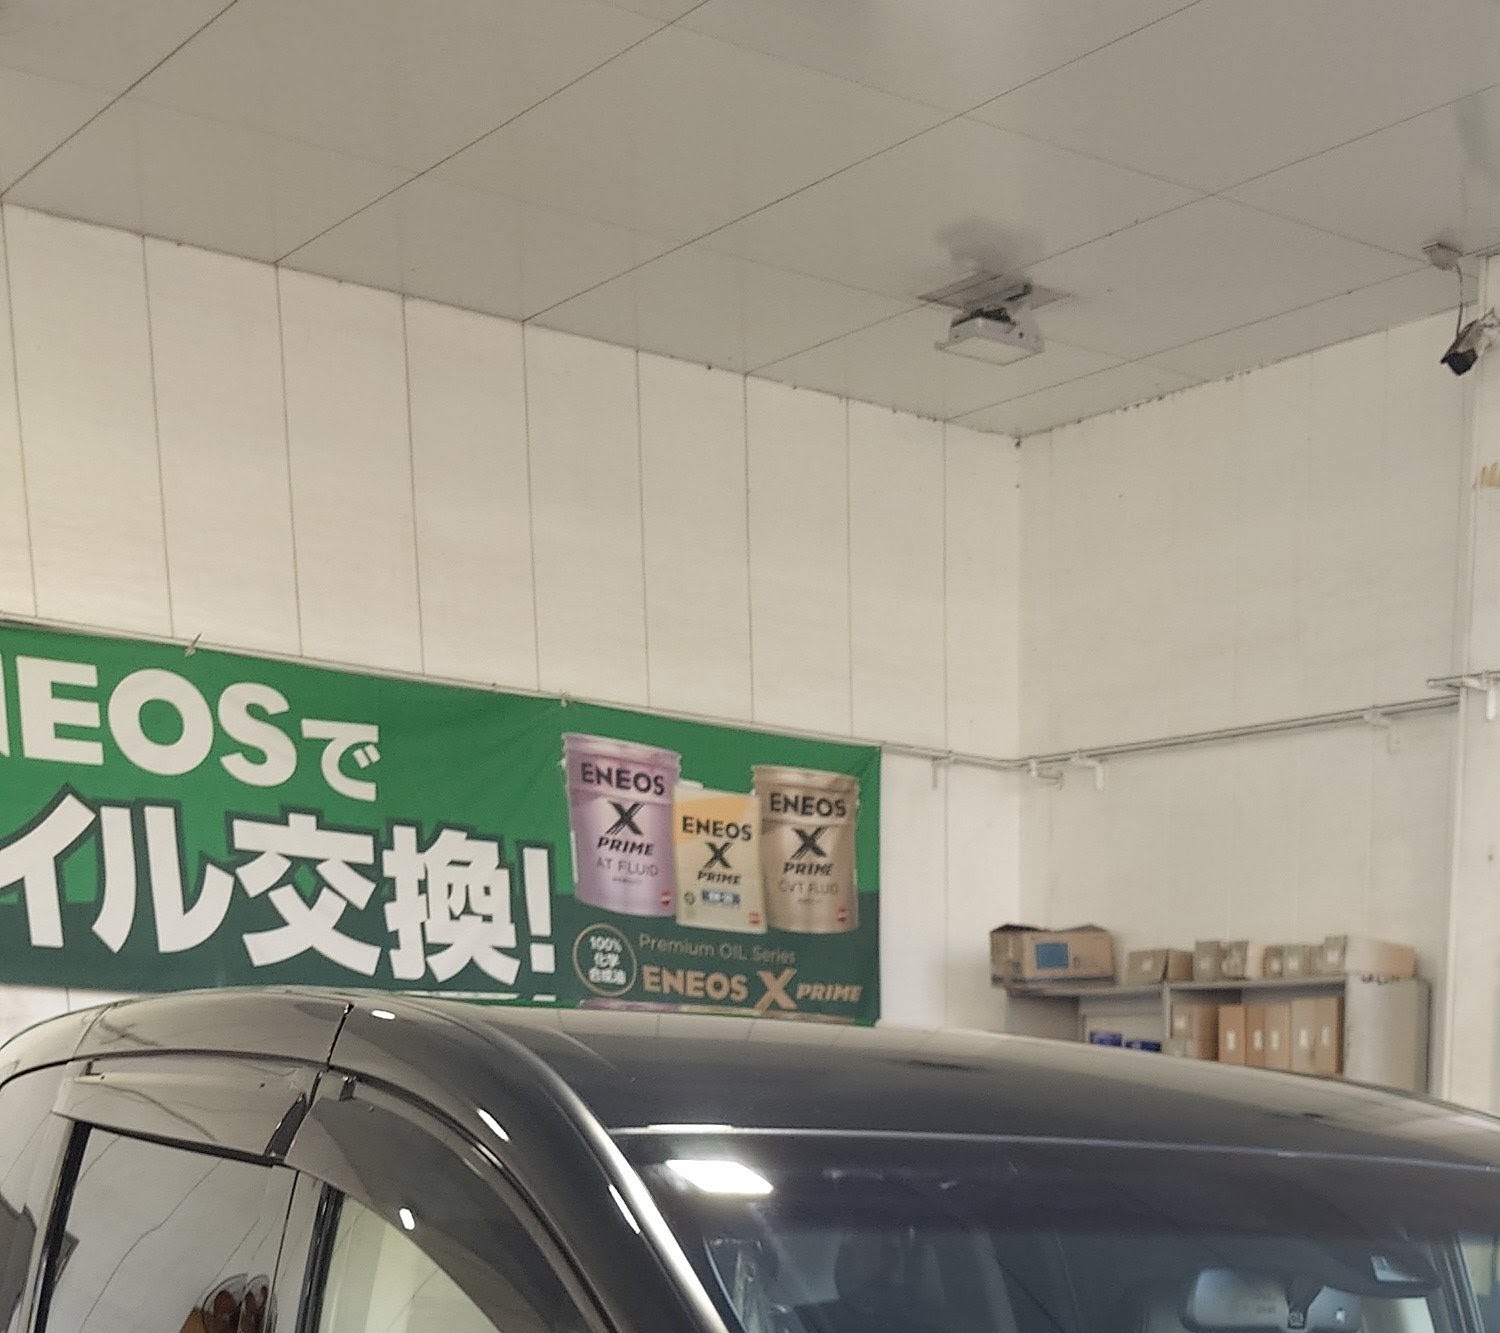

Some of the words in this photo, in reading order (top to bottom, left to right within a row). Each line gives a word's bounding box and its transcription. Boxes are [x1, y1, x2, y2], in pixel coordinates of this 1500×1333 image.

[0, 654, 382, 802] EOSで
[580, 762, 665, 796] ENEOS
[604, 800, 645, 836] X
[770, 793, 847, 818] ENEOS
[682, 816, 753, 841] ENEOS
[790, 825, 828, 860] X
[597, 836, 654, 857] PRIME
[702, 841, 732, 869] X
[697, 870, 742, 886] PRIME
[783, 862, 834, 877] PRIME
[639, 932, 715, 957] Premium
[752, 947, 796, 964] Series
[642, 964, 748, 1002] ENEOS
[755, 966, 798, 1010] X
[796, 982, 863, 1002] PRIME
